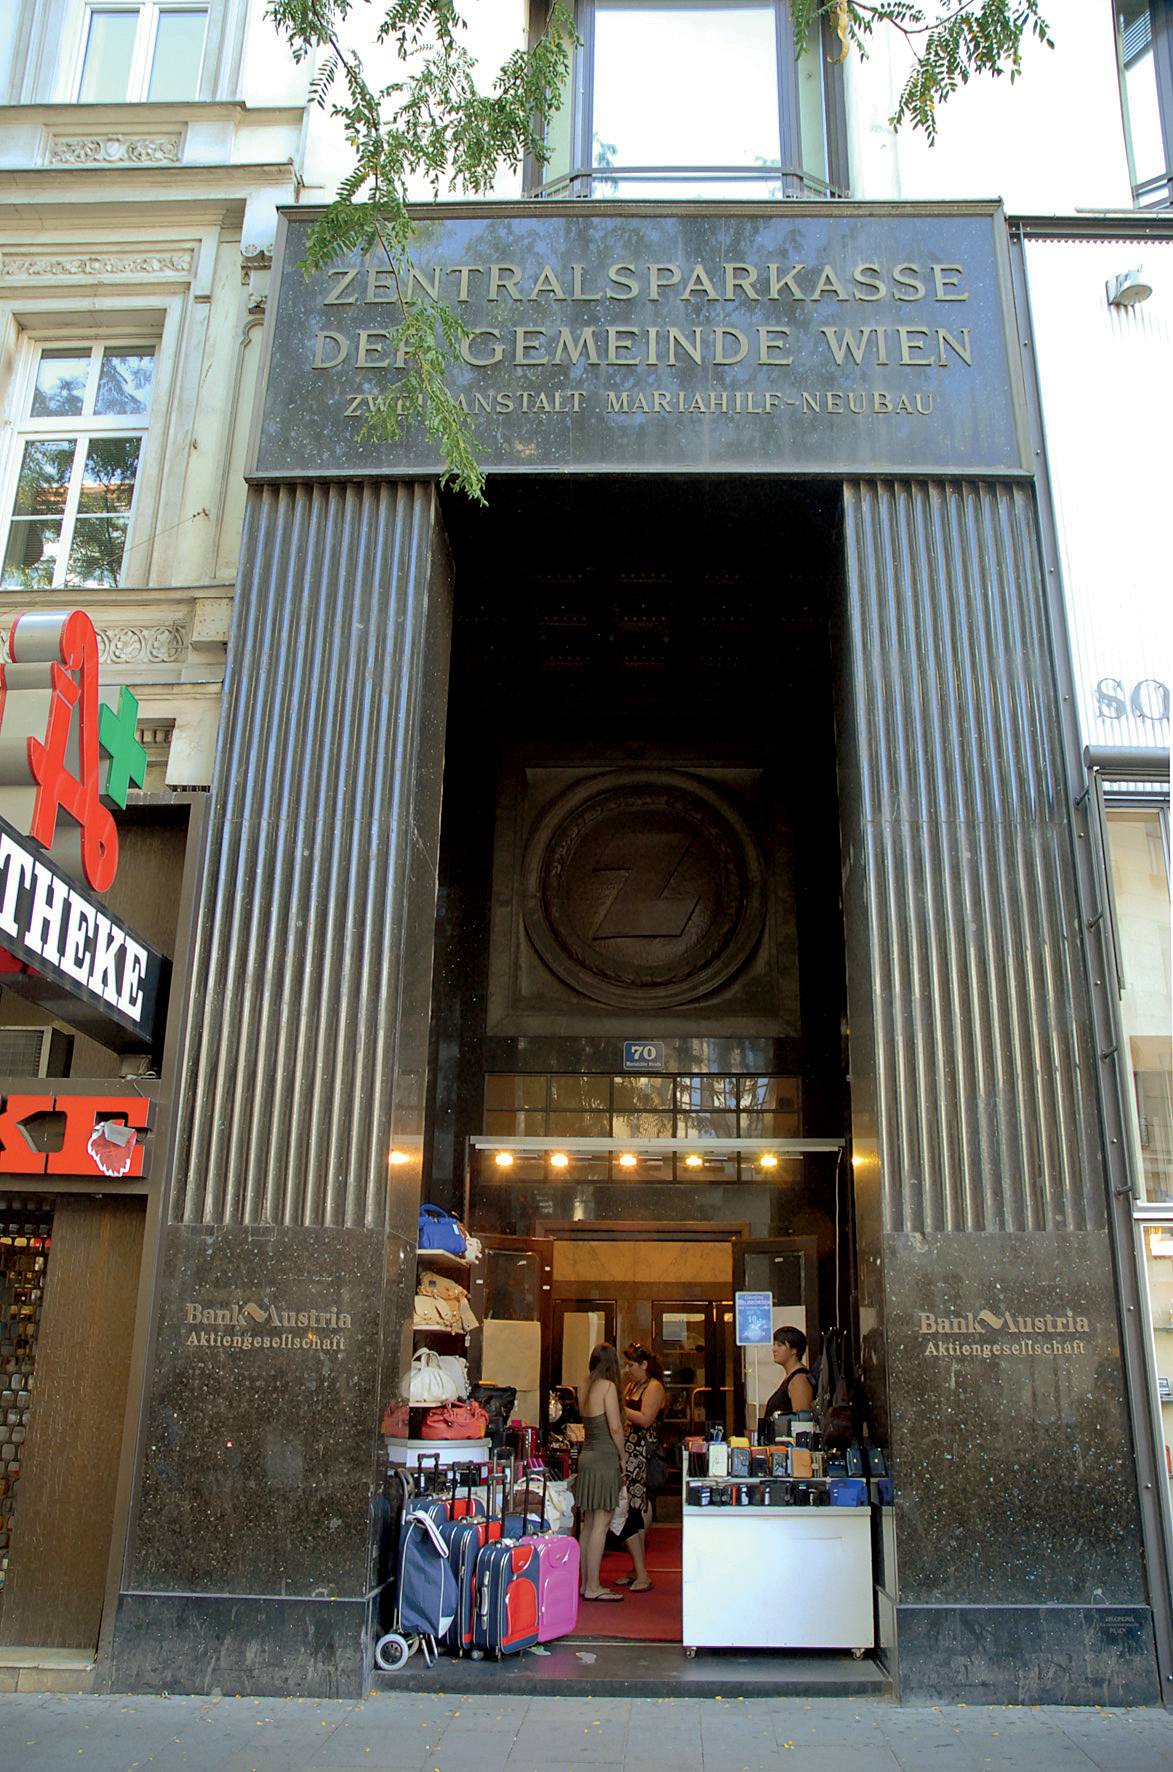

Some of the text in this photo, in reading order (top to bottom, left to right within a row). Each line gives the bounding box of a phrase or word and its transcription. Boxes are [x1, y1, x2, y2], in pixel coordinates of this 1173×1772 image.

[324, 263, 969, 306] ZENTRALSPARKASSE
[460, 327, 794, 367] GEMEINDE
[820, 327, 972, 367] WIEN
[605, 391, 935, 416] MARIAHILF-NEUBAU
[631, 1045, 657, 1060] 70
[184, 1303, 352, 1329] Bank Austria
[919, 1311, 1090, 1334] Bank Austria
[186, 1331, 346, 1350] Aktiengesellschaft
[924, 1340, 1086, 1358] Aktiengesellschaft
